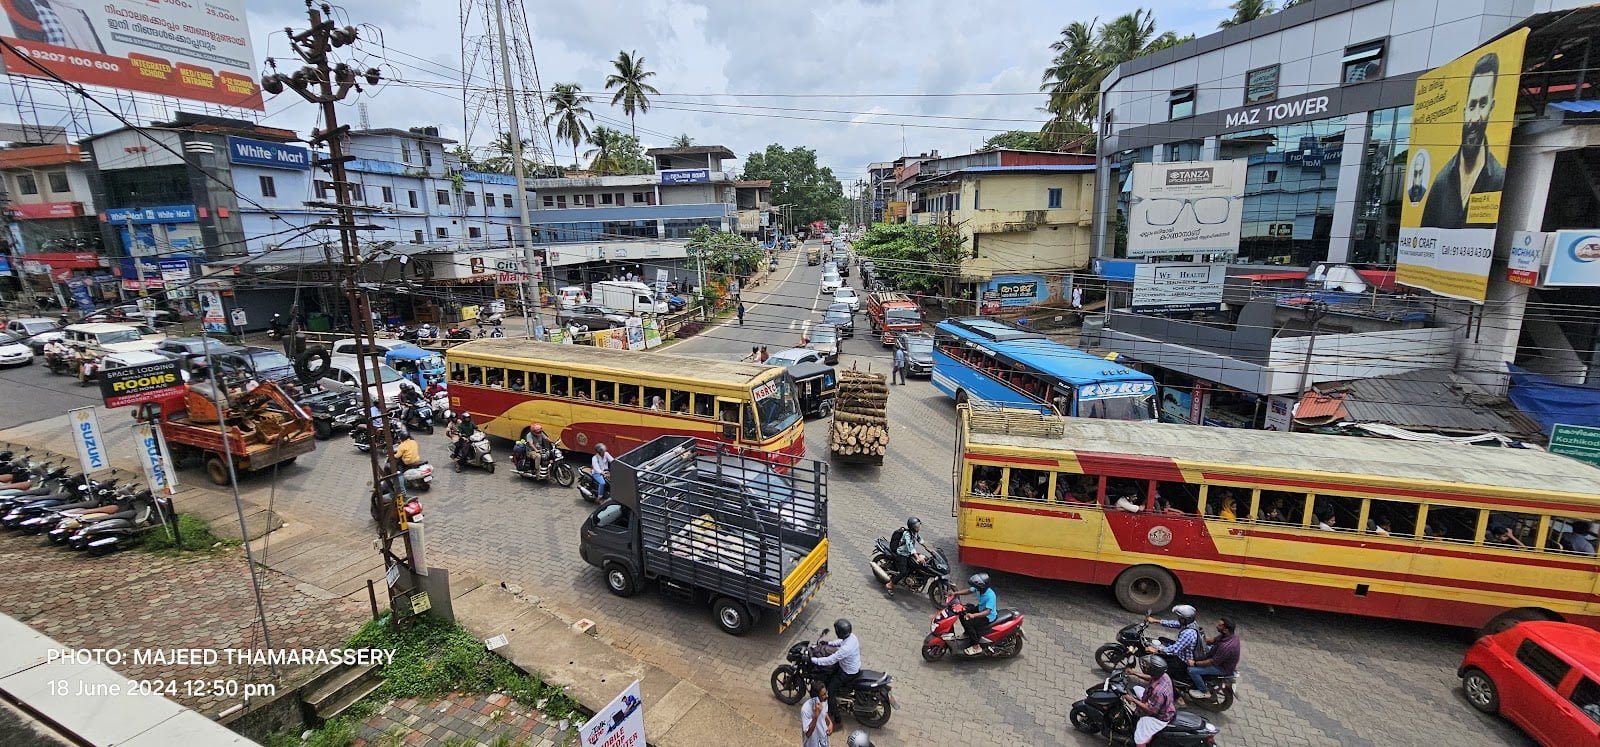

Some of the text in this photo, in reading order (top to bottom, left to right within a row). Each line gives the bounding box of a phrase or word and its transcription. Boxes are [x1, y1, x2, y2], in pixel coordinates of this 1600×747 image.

[31, 50, 119, 72] 9207 100 600
[131, 58, 172, 73] INTEGRATED
[140, 67, 166, 80] SCHOOL
[1225, 96, 1329, 128] MAZ TOWER
[236, 143, 304, 164] White Mart
[1179, 170, 1210, 178] TANZA
[1400, 237, 1437, 249] HAIR CRAFT
[500, 272, 541, 281] Makt
[107, 363, 175, 379] SPACE LODGING
[112, 373, 176, 392] ROOMS
[755, 383, 777, 399] KSRTC
[80, 422, 102, 468] SUZUKI
[1556, 436, 1600, 447] Kozhikod
[144, 437, 166, 486] SUZUKI
